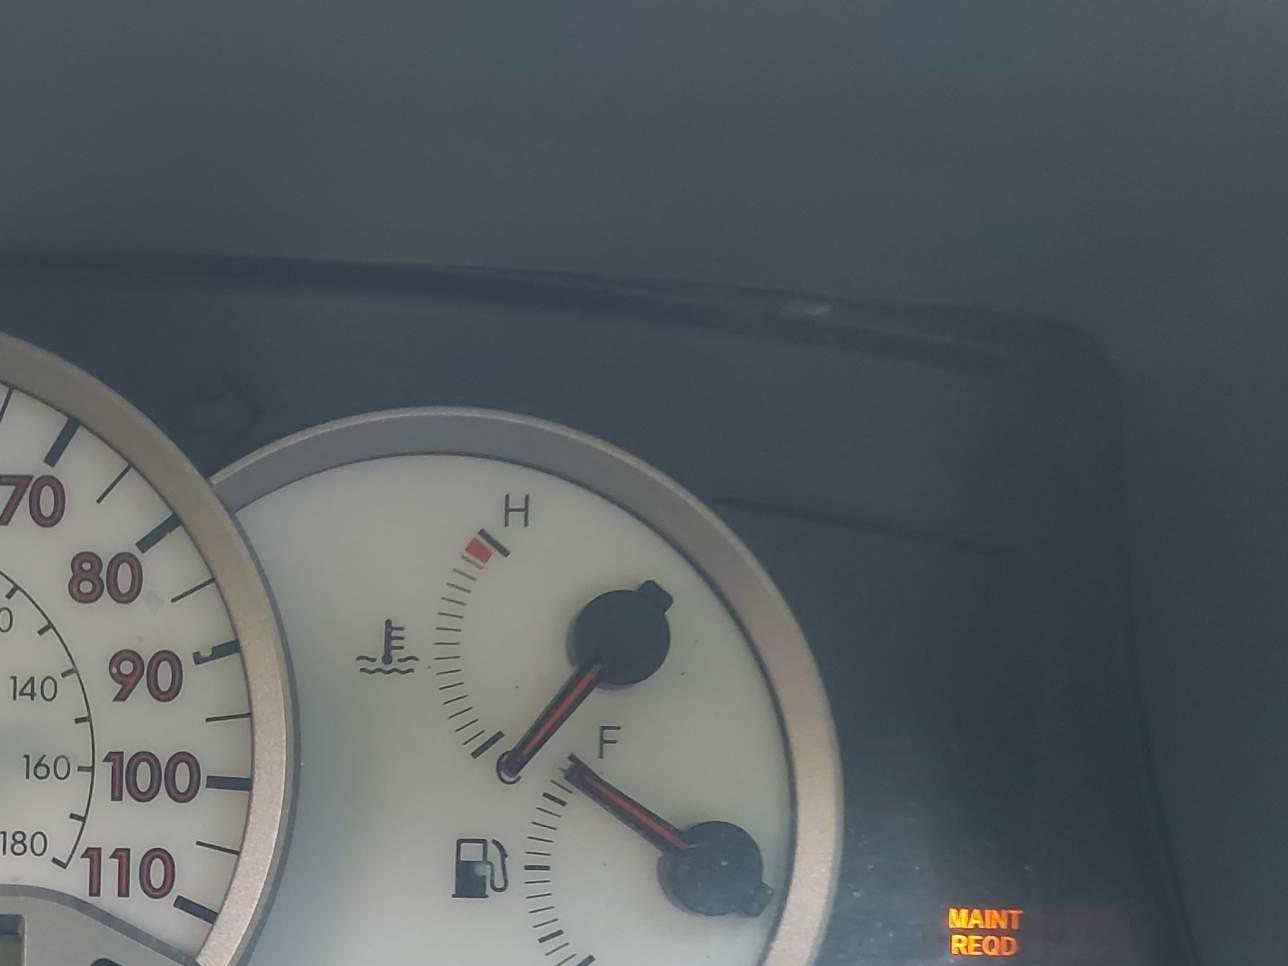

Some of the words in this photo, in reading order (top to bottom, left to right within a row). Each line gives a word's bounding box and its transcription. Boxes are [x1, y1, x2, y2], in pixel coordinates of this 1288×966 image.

[503, 494, 530, 526] H
[68, 551, 144, 604] 80
[10, 677, 59, 703] 140
[109, 650, 183, 702] 90
[598, 726, 621, 758] F
[24, 754, 71, 782] 160
[102, 751, 201, 803] 100
[0, 831, 48, 857] 180
[81, 848, 175, 899] 110
[948, 908, 1022, 931] MAINT
[951, 935, 1017, 957] REQD
